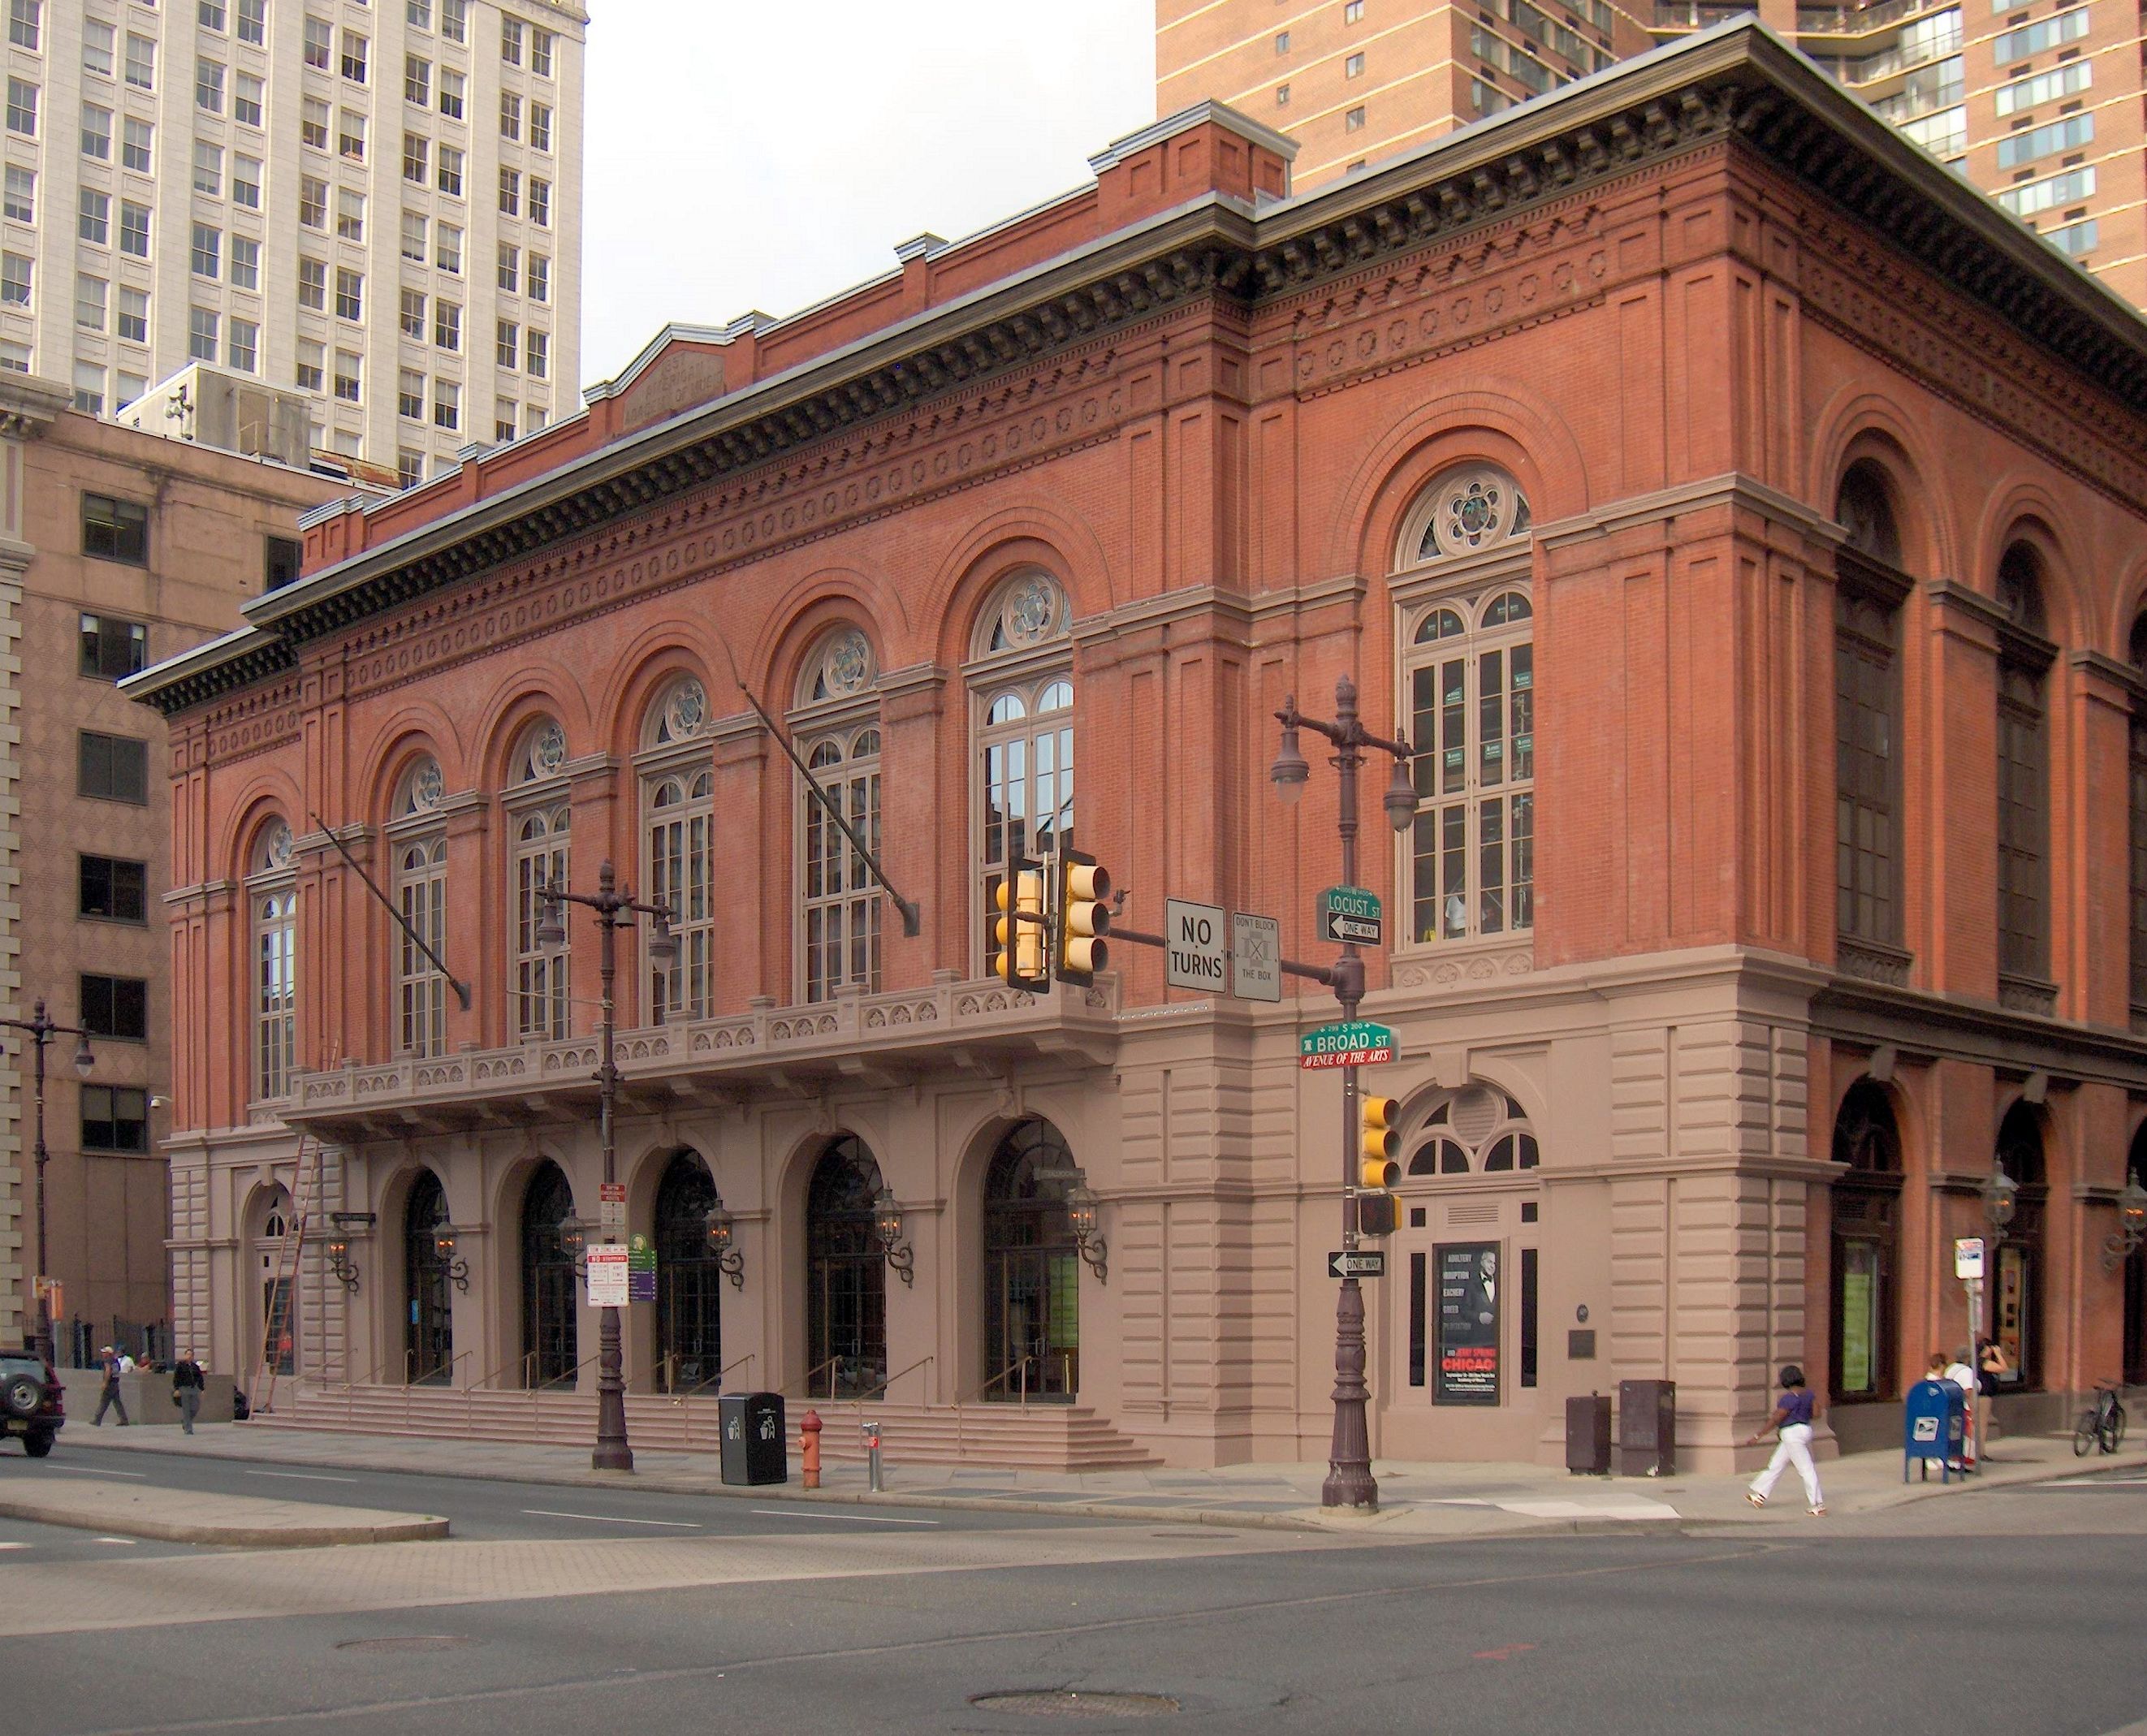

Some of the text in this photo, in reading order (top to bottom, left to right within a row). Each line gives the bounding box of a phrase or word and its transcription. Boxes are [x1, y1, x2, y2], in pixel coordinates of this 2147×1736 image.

[1328, 894, 1380, 918] LOCUST ST
[1181, 915, 1212, 945] NO
[1255, 919, 1276, 931] BLOCK
[1344, 922, 1376, 936] ONE WAY
[1171, 950, 1223, 978] TURNS
[1242, 968, 1272, 981] THE BOX
[1342, 1024, 1348, 1033] S
[1316, 1032, 1388, 1052] BROAD ST
[1302, 1049, 1389, 1068] AVENUE OF THE ARTS
[1346, 1259, 1380, 1270] ONE WAY
